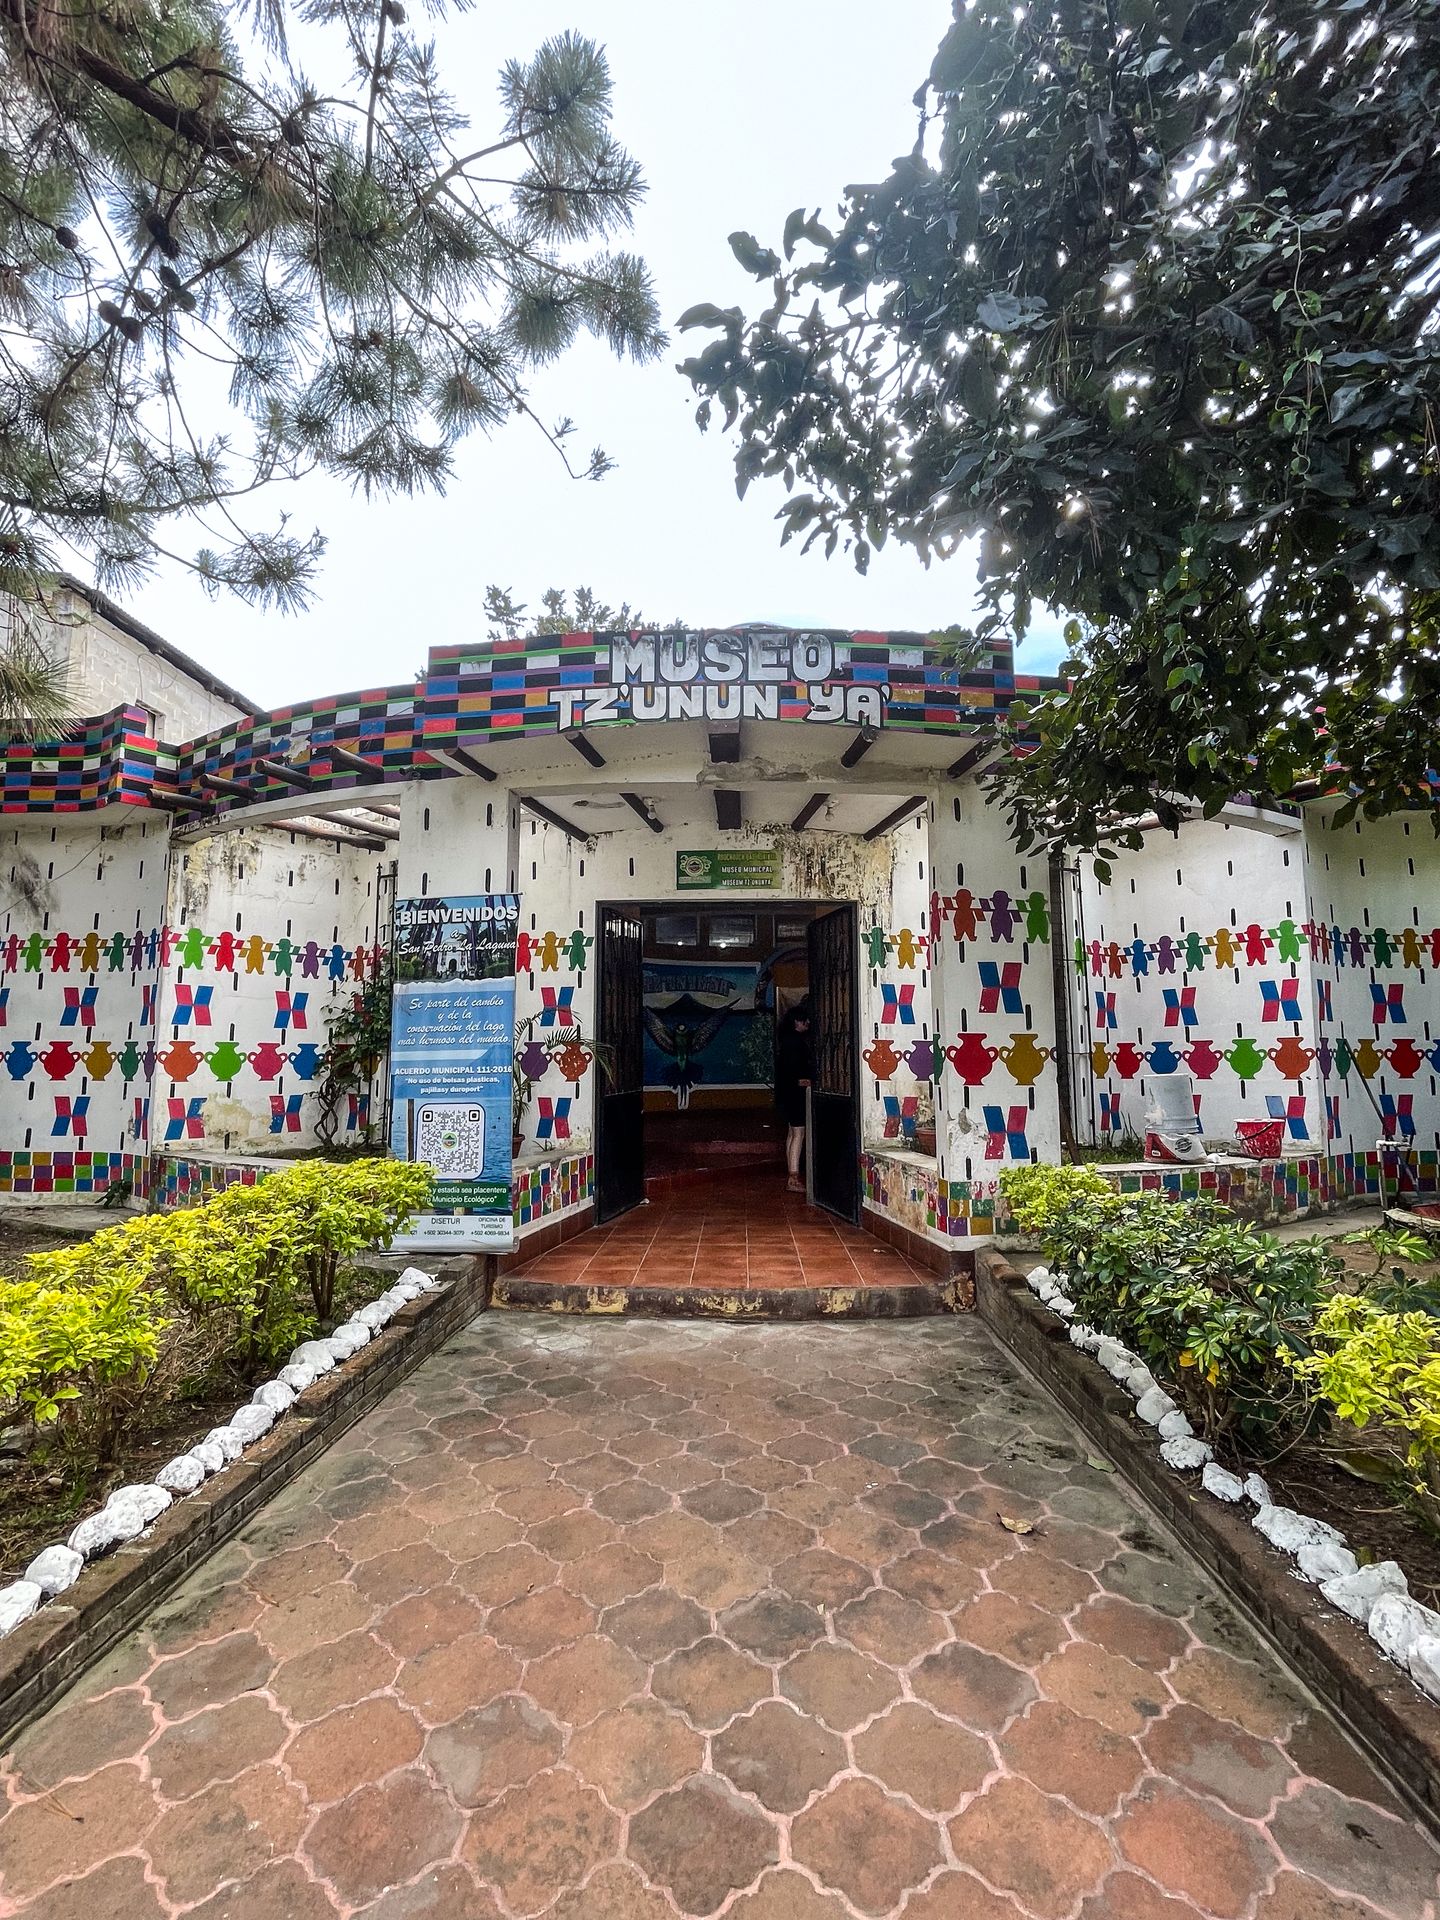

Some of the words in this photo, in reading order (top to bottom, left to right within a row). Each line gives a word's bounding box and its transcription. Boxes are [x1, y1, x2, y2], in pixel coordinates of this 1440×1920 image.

[611, 632, 833, 684] MUSEO
[548, 682, 779, 732] TZ'UNUN
[804, 682, 892, 730] YA'
[400, 906, 518, 925] BIENVENIDOS
[450, 930, 460, 938] a
[398, 942, 421, 955] San
[423, 941, 454, 954] Pedro
[457, 940, 473, 952] La
[476, 938, 516, 953] Laguna
[409, 998, 424, 1010] Se
[425, 998, 451, 1012] parte
[454, 996, 470, 1007] del
[471, 995, 504, 1006] cambio
[437, 1012, 445, 1022] y
[448, 1010, 460, 1020] de
[461, 1008, 473, 1019] la
[406, 1021, 462, 1034] conservación
[465, 1020, 480, 1032] del
[483, 1021, 505, 1034] lago
[397, 1035, 416, 1047] más
[418, 1033, 456, 1045] hermoso
[458, 1033, 474, 1044] del
[476, 1032, 511, 1044] mundo.
[394, 1068, 430, 1076] ACUERDO
[431, 1066, 475, 1075] MUNICIPAL
[437, 1186, 460, 1194] estadía
[473, 1186, 507, 1195] placentera
[432, 1196, 463, 1204] Municipio
